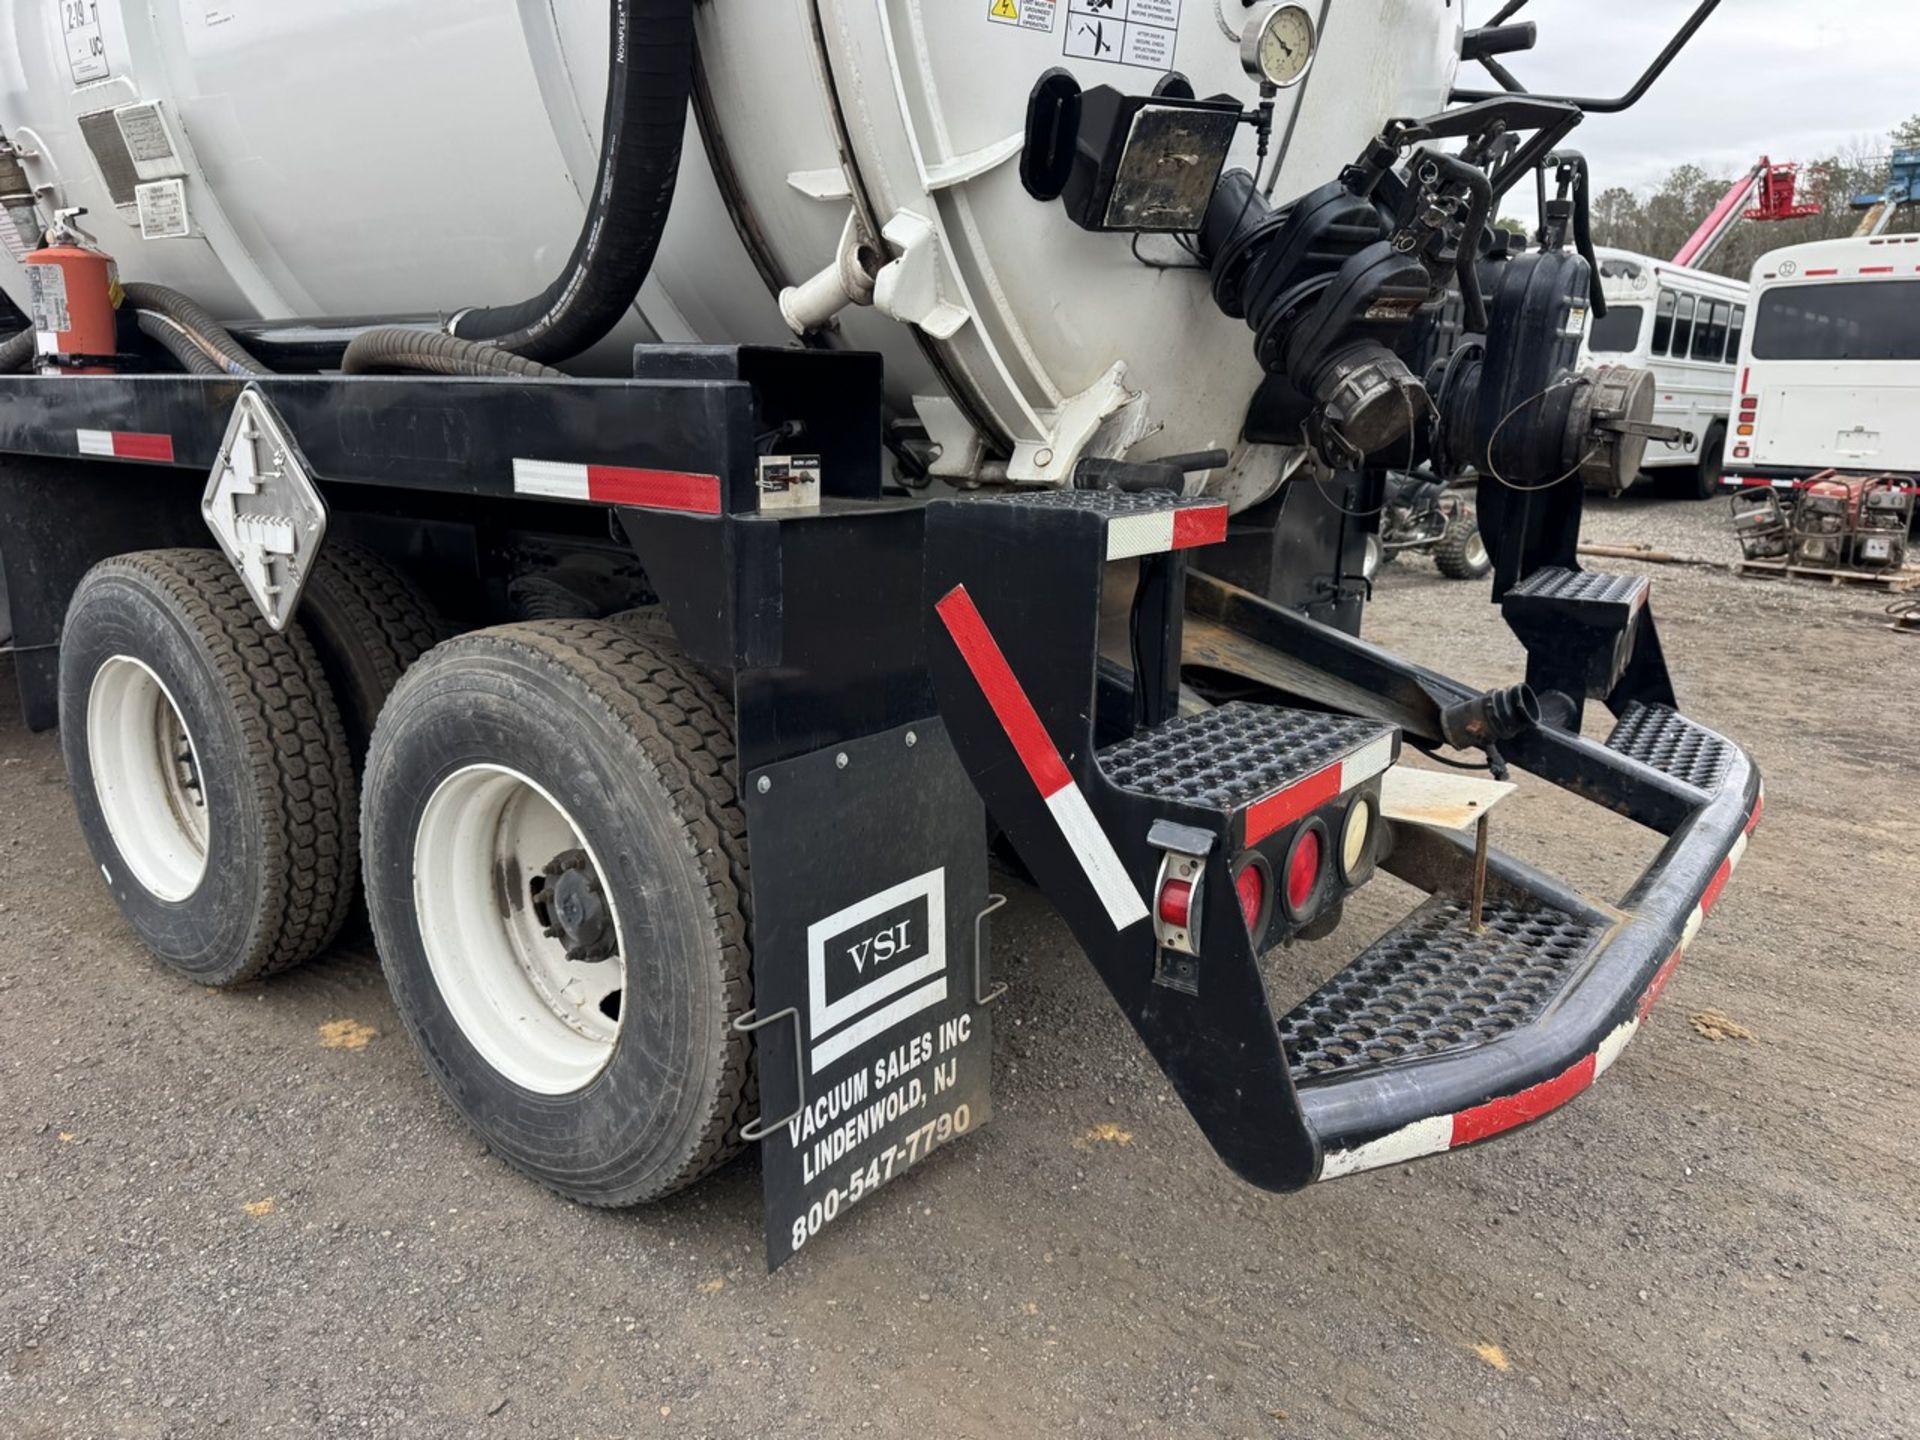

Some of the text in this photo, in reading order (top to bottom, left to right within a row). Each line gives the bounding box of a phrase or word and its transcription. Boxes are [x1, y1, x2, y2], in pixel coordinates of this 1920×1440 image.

[1023, 20, 1049, 29] OPERATION
[1024, 6, 1051, 15] GROUNDED
[1027, 13, 1047, 21] BEFORE
[847, 920, 911, 974] VSI
[788, 1013, 971, 1148] VACUUM SALES INC
[803, 1058, 957, 1185] LINDENWOLD, NJ
[791, 1104, 970, 1251] 800-547-7790
